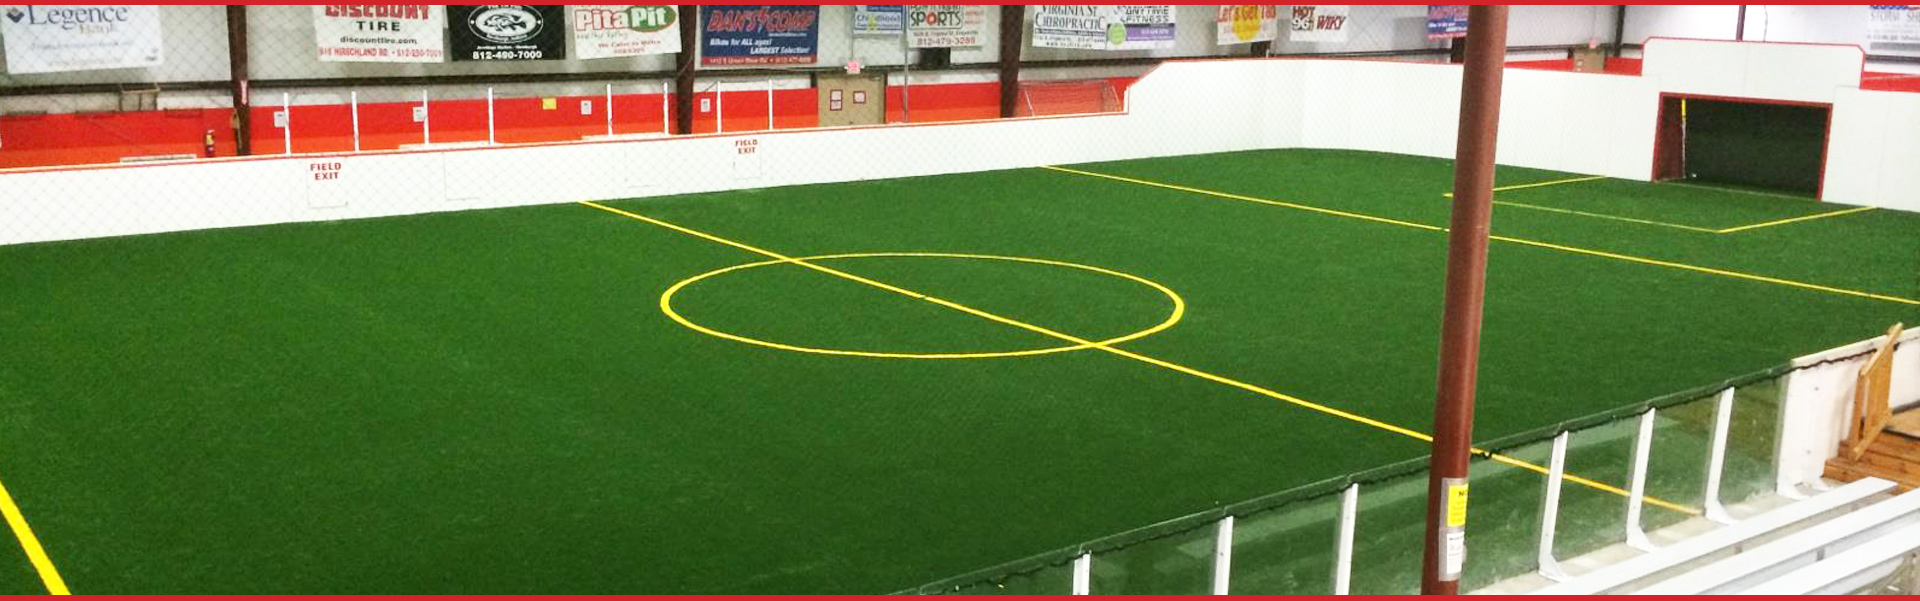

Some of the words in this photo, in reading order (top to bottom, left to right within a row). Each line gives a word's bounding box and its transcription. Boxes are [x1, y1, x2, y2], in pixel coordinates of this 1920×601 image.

[325, 5, 429, 20] DISCOUNT
[1042, 5, 1085, 16] VIRGINIA
[1292, 6, 1315, 19] HOT
[27, 5, 129, 30] Legence
[574, 9, 629, 31] Pita
[631, 7, 667, 28] Pit
[910, 11, 961, 26] SPORTS
[1035, 12, 1105, 31] CHIROPRACTIC
[1126, 15, 1169, 23] FITNESS
[1316, 15, 1346, 30] WIKY
[356, 20, 401, 31] TIRE
[340, 36, 418, 45] discounttire.com
[740, 38, 754, 46] ALL
[334, 47, 377, 57] HIRSCHLAND
[750, 46, 781, 55] LARGEST
[735, 139, 758, 147] FIELD
[310, 162, 342, 171] FIELD
[314, 171, 339, 181] EXIT
